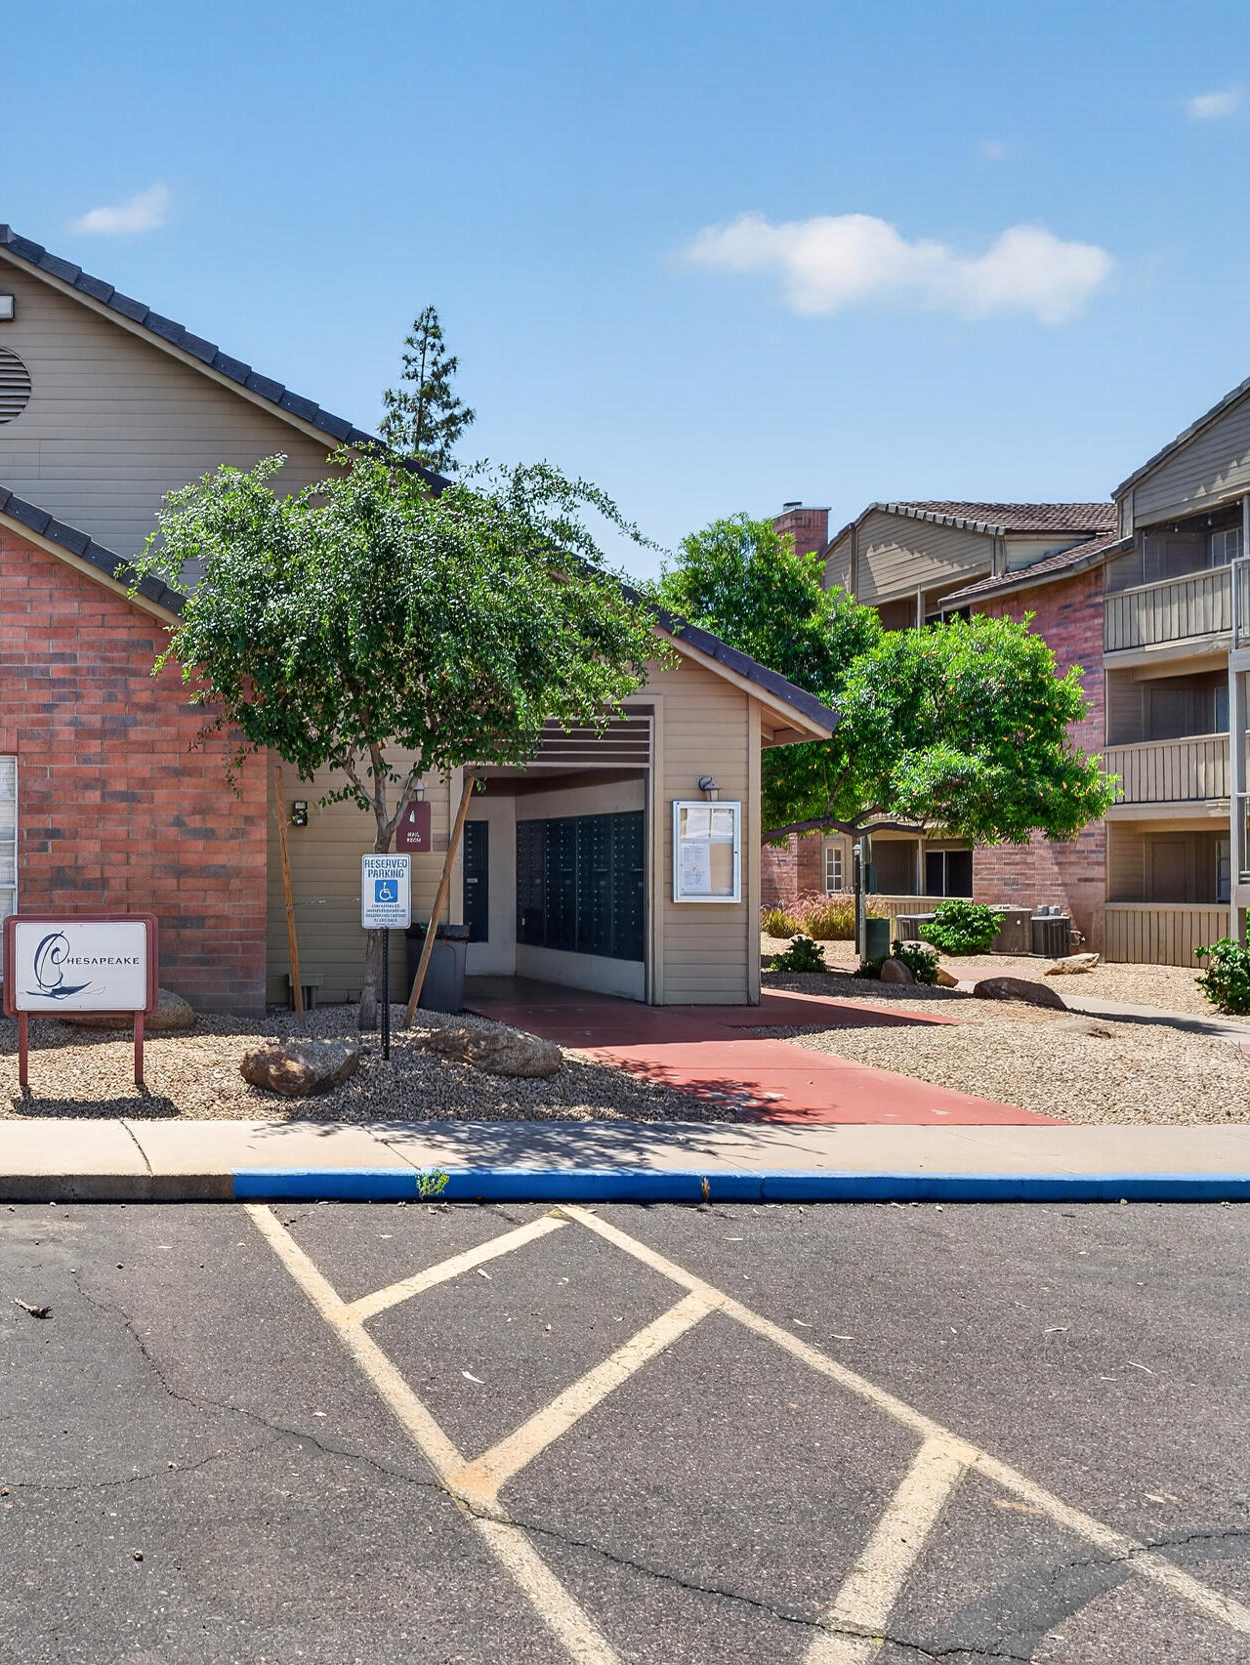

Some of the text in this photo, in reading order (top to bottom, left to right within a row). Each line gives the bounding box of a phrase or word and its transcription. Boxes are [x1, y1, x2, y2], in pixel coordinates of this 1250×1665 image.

[364, 859, 408, 869] RESERVED
[368, 869, 405, 878] PARKING
[33, 930, 140, 988] CHESAPEAKE
